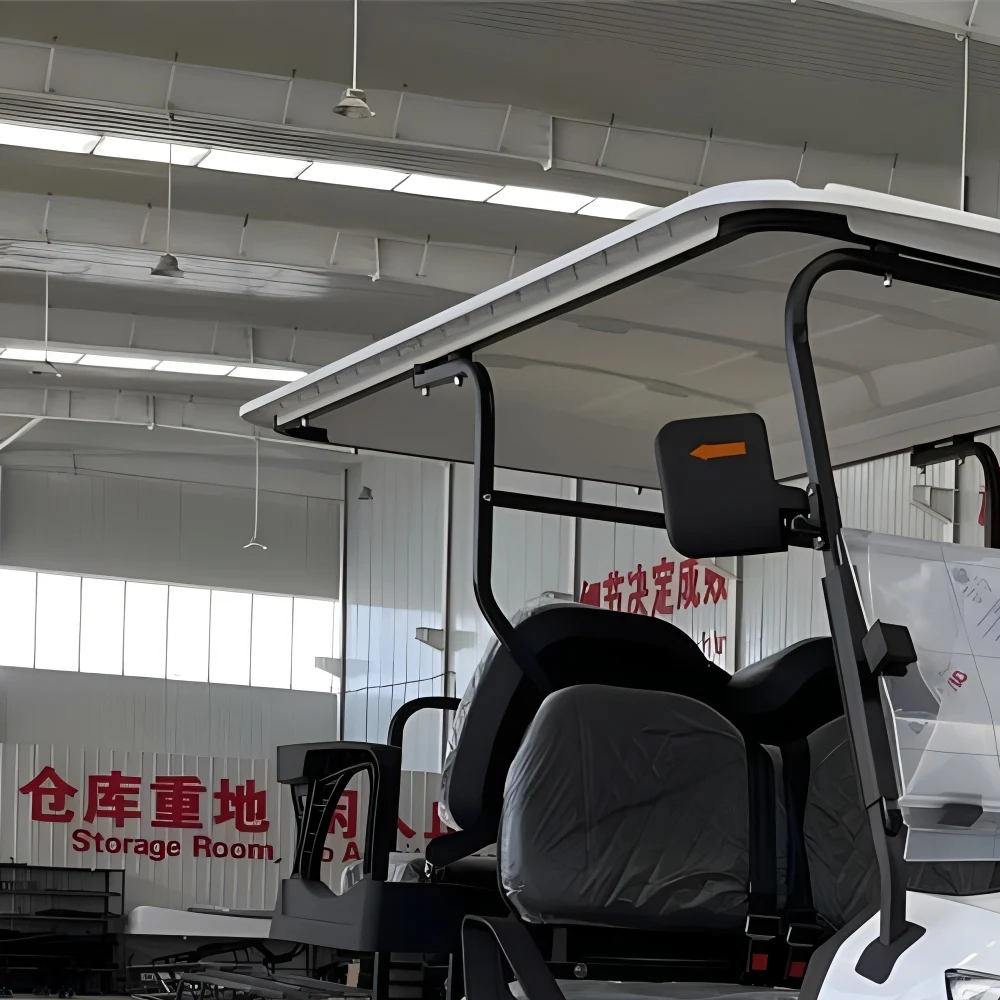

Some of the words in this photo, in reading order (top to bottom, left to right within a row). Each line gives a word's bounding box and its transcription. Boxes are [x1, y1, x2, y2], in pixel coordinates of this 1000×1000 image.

[19, 766, 270, 833] 仓库重地
[72, 829, 180, 861] Storage
